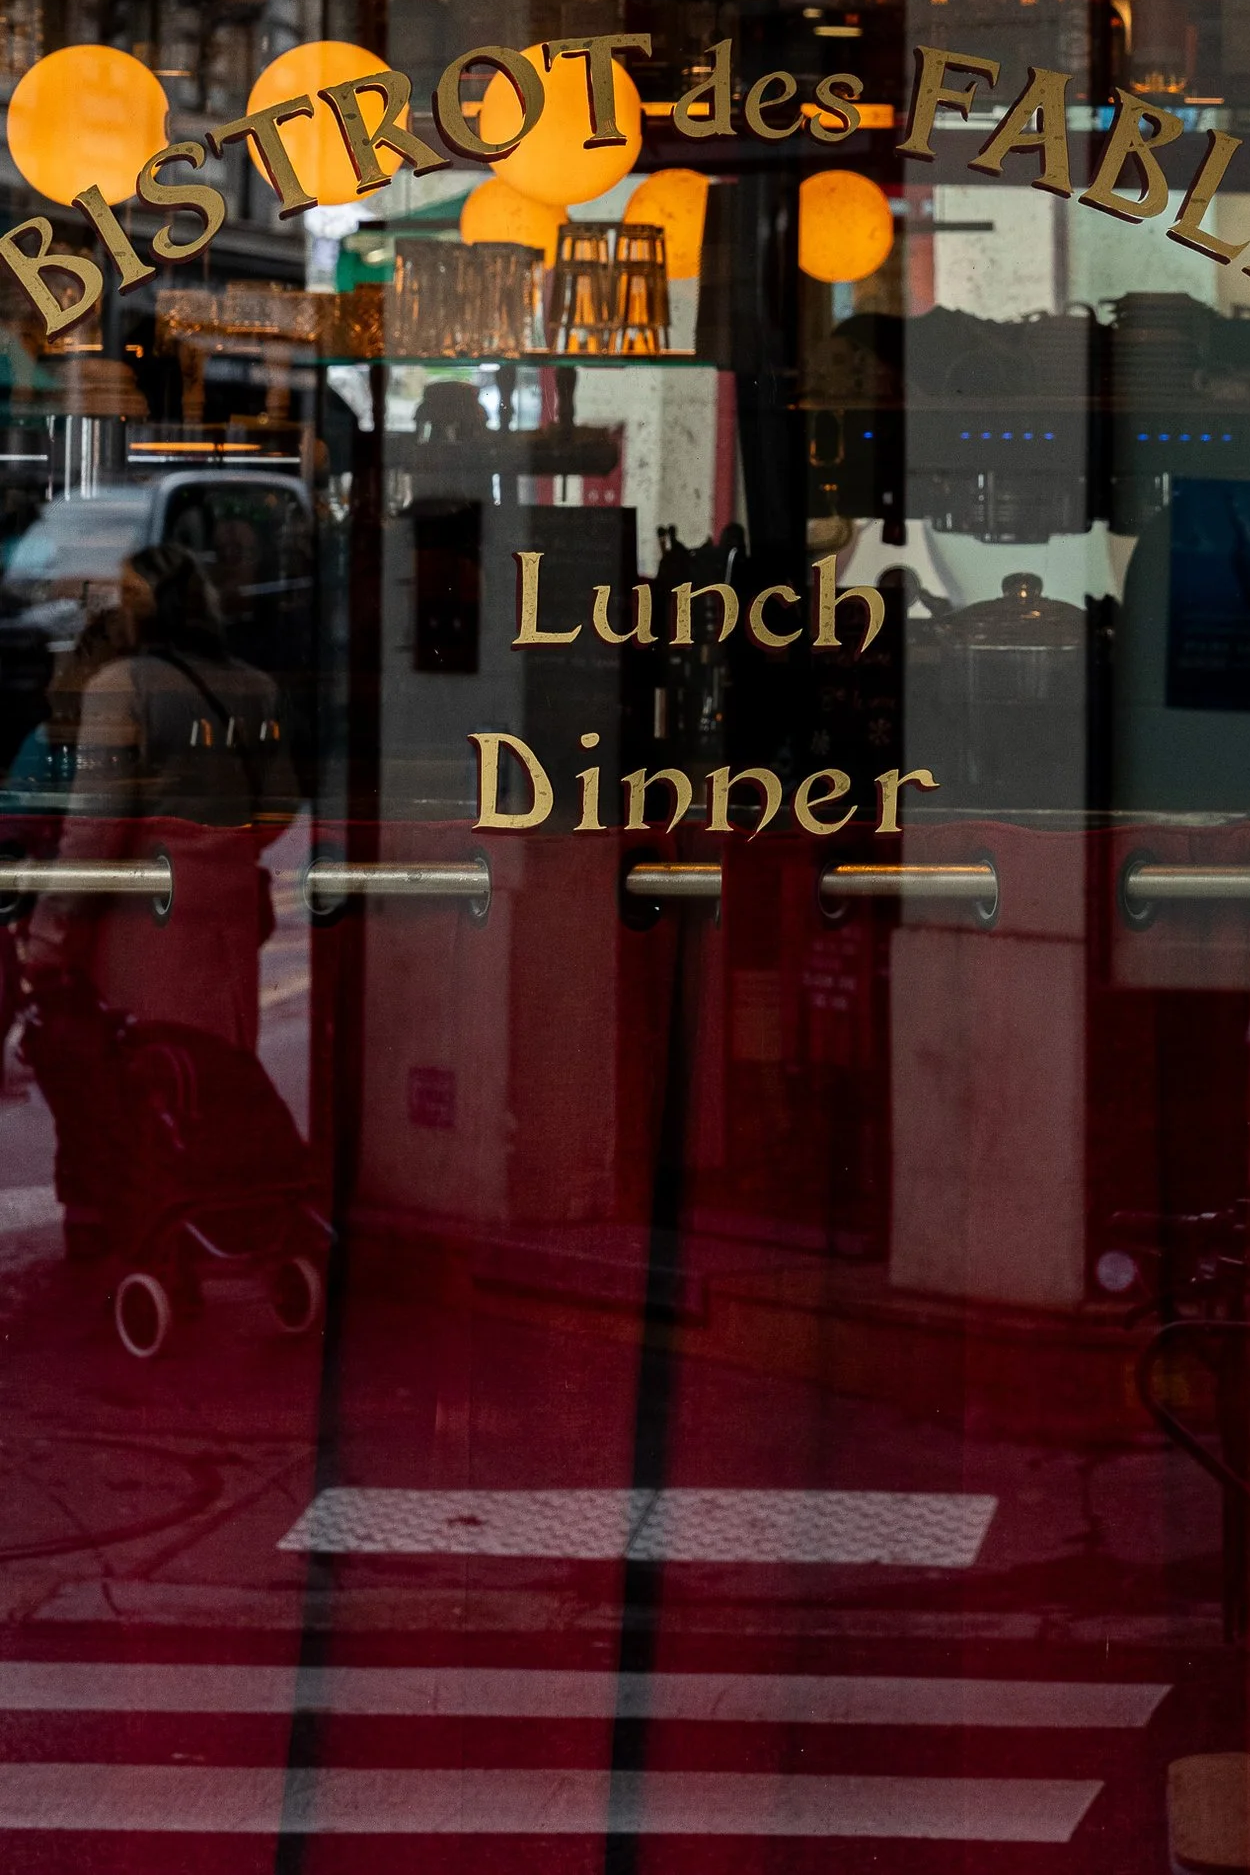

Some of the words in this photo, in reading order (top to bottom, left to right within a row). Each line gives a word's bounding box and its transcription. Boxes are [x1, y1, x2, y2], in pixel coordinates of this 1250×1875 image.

[0, 33, 653, 343] BISTROT
[671, 38, 865, 145] des
[511, 551, 886, 653] Lunch
[467, 731, 940, 842] Dinner
